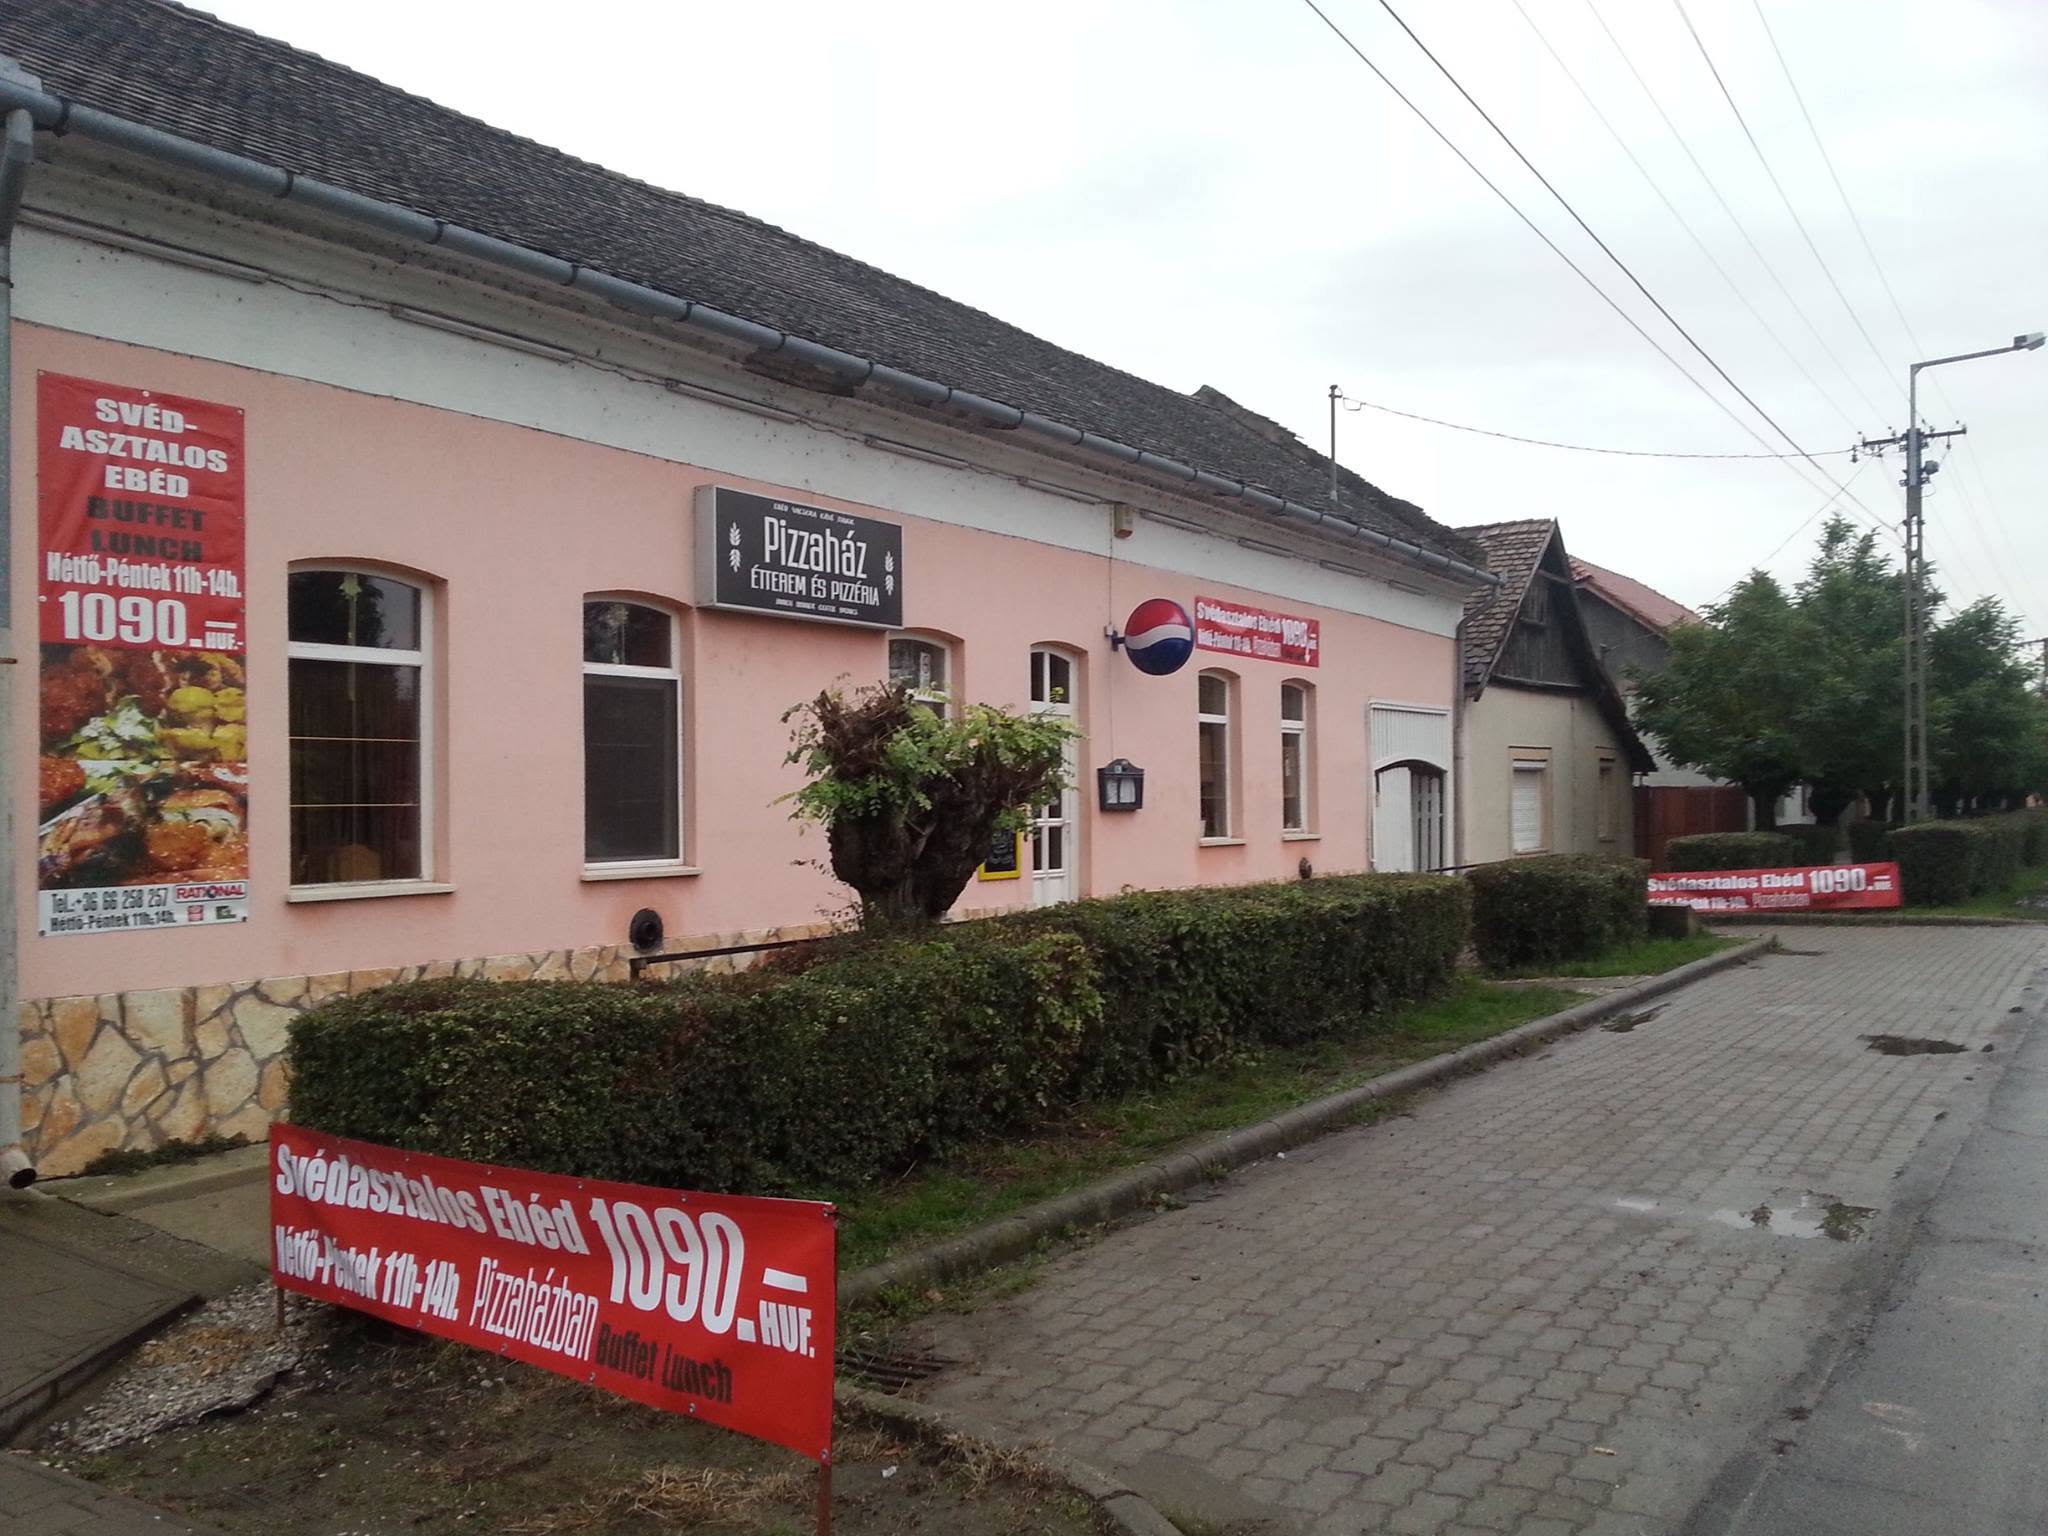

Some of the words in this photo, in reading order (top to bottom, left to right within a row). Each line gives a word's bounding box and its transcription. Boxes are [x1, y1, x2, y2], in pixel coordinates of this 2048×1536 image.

[95, 398, 198, 433] SVÉD-
[59, 425, 228, 472] ASZTALOS
[104, 464, 189, 498] EBÉD
[87, 495, 207, 531] BUFFET
[91, 528, 204, 563] LUNCH
[763, 516, 868, 579] Pizzaház
[47, 552, 171, 593] Hétfő-Péntek
[751, 565, 806, 596] ÉTTEREM
[811, 574, 827, 599] ÉS
[831, 574, 880, 606] PIZZÉRIA
[176, 884, 244, 899] RATIONAL
[1648, 875, 1759, 891] Svédasztalos
[1761, 872, 1804, 888] Ebéd
[275, 1143, 486, 1235] Svédasztalos
[479, 1186, 590, 1255] Ebéd
[382, 1251, 460, 1321] 11h-14h.
[469, 1256, 600, 1362] Pizzaházban
[759, 1299, 816, 1359] HUF.
[595, 1322, 658, 1382] Buffet
[662, 1343, 734, 1404] Lunch
